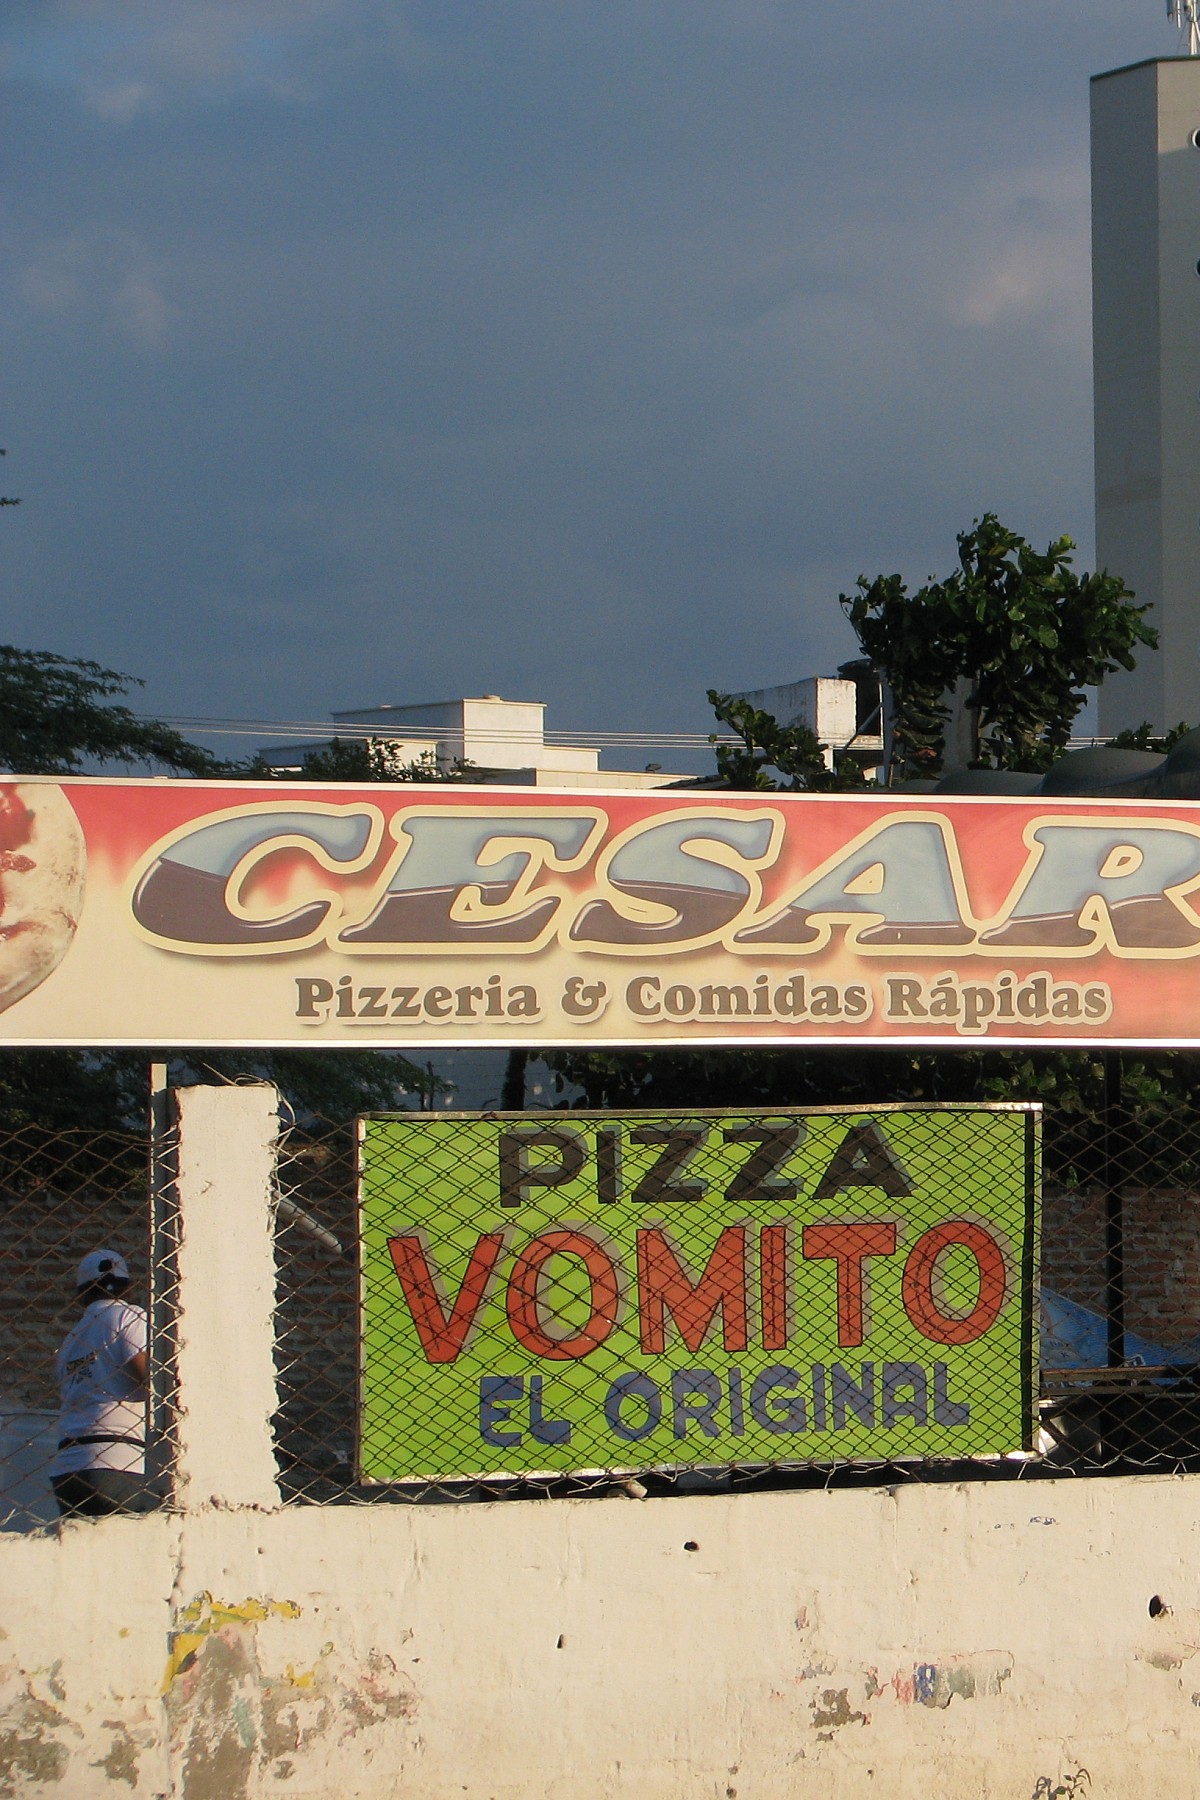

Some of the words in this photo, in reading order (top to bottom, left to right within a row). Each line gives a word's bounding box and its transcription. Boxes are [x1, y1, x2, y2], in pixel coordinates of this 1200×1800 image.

[295, 975, 542, 1018] Pizzeria
[561, 976, 607, 1017] &
[625, 975, 868, 1017] Comidas
[886, 975, 1107, 1028] Rápidas
[500, 1118, 917, 1208] PIZZA
[386, 1217, 1008, 1365] VOMITO
[479, 1374, 571, 1447] EL
[603, 1360, 970, 1441] ORIGINAL
